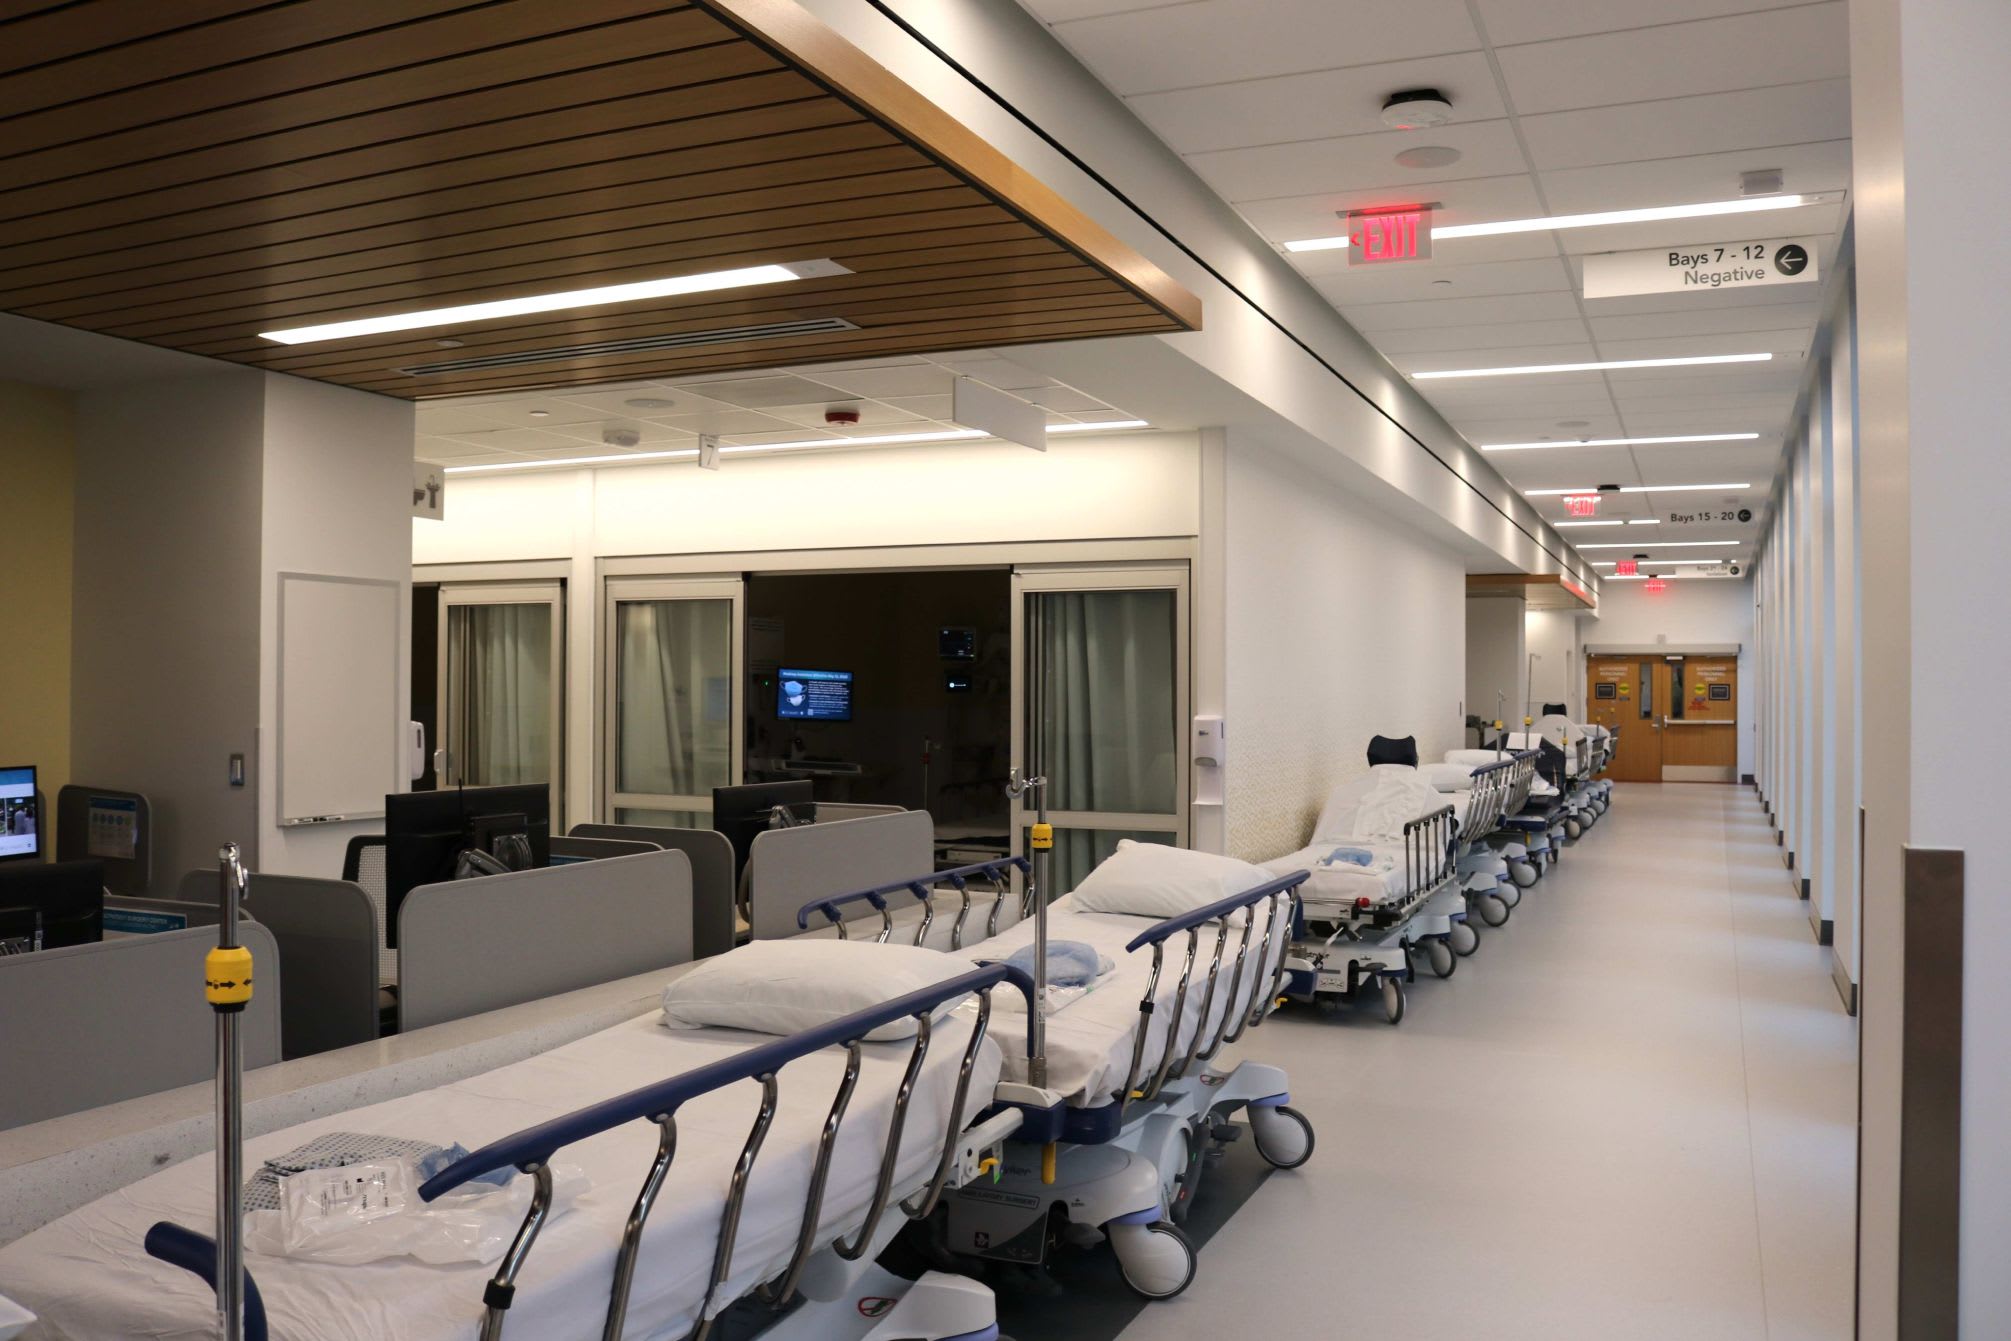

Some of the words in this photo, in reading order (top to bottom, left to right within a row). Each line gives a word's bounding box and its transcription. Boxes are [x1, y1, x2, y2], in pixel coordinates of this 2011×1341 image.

[1363, 214, 1421, 261] EXIT
[1669, 252, 1708, 269] Bays
[1714, 248, 1725, 263] 7
[1743, 244, 1766, 260] 12
[1684, 266, 1766, 288] Negative
[1571, 496, 1595, 516] EXIT
[1670, 512, 1695, 524] Bays
[1698, 512, 1711, 521] 15
[1721, 511, 1735, 521] 20
